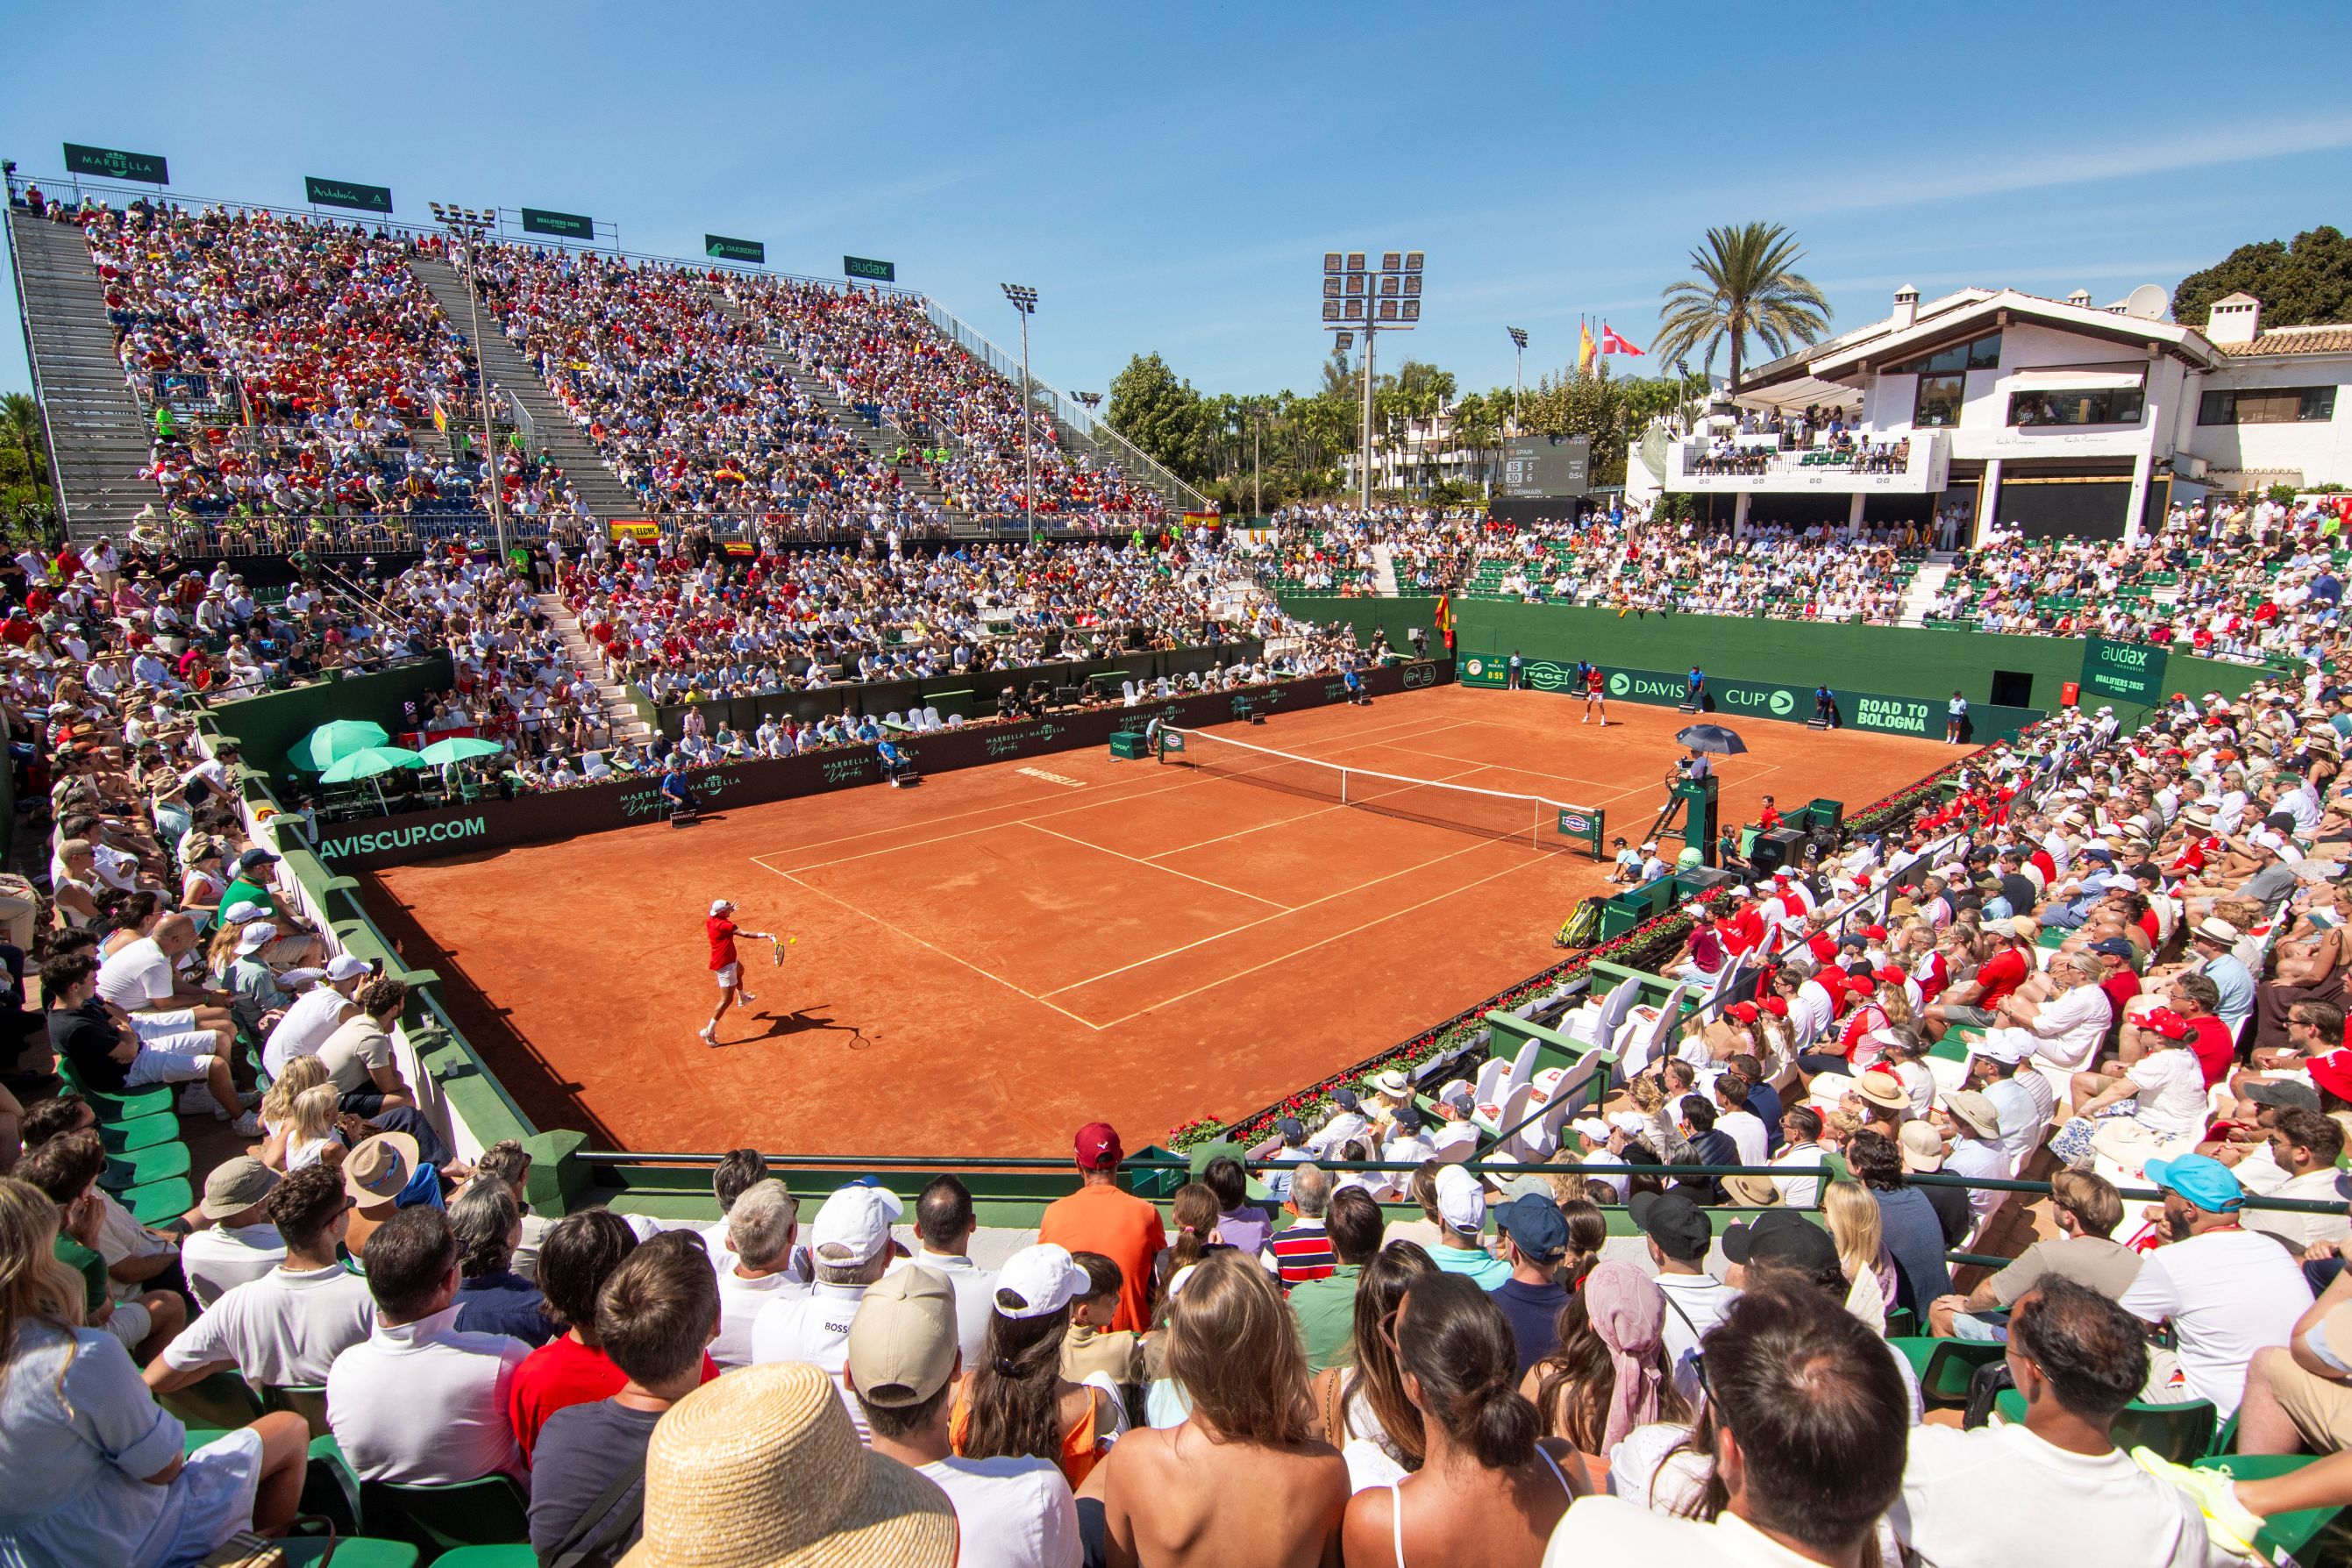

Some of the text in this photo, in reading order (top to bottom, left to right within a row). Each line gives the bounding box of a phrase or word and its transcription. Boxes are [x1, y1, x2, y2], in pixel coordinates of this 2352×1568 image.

[82, 155, 152, 172] MARBELLA
[313, 185, 359, 202] Andalucía
[537, 217, 567, 226] QUALIFIERS
[726, 245, 761, 256] OAKBERRY
[851, 260, 887, 275] audax
[1509, 462, 1533, 471] 15 5
[1508, 474, 1533, 482] 30 6
[2101, 645, 2148, 666] audax
[2113, 663, 2145, 673] renovables
[1488, 671, 1504, 680] 0:55
[1529, 671, 1563, 681] FAGE
[2095, 674, 2145, 691] QUALIFIERS 2025
[1636, 680, 1765, 706] DAVIS CUP
[1859, 698, 1928, 717] ROAD TO
[1120, 713, 1151, 723] MARBELLA
[1857, 711, 1925, 731] BOLOGNA
[986, 726, 1066, 745] MARBELLA MARBELLA
[823, 757, 870, 770] MARBELLA
[1016, 767, 1087, 788] MARBELLA
[671, 812, 695, 821] RENAULT
[320, 816, 486, 860] AVISCUP.COM
[824, 1322, 848, 1334] BOSS
